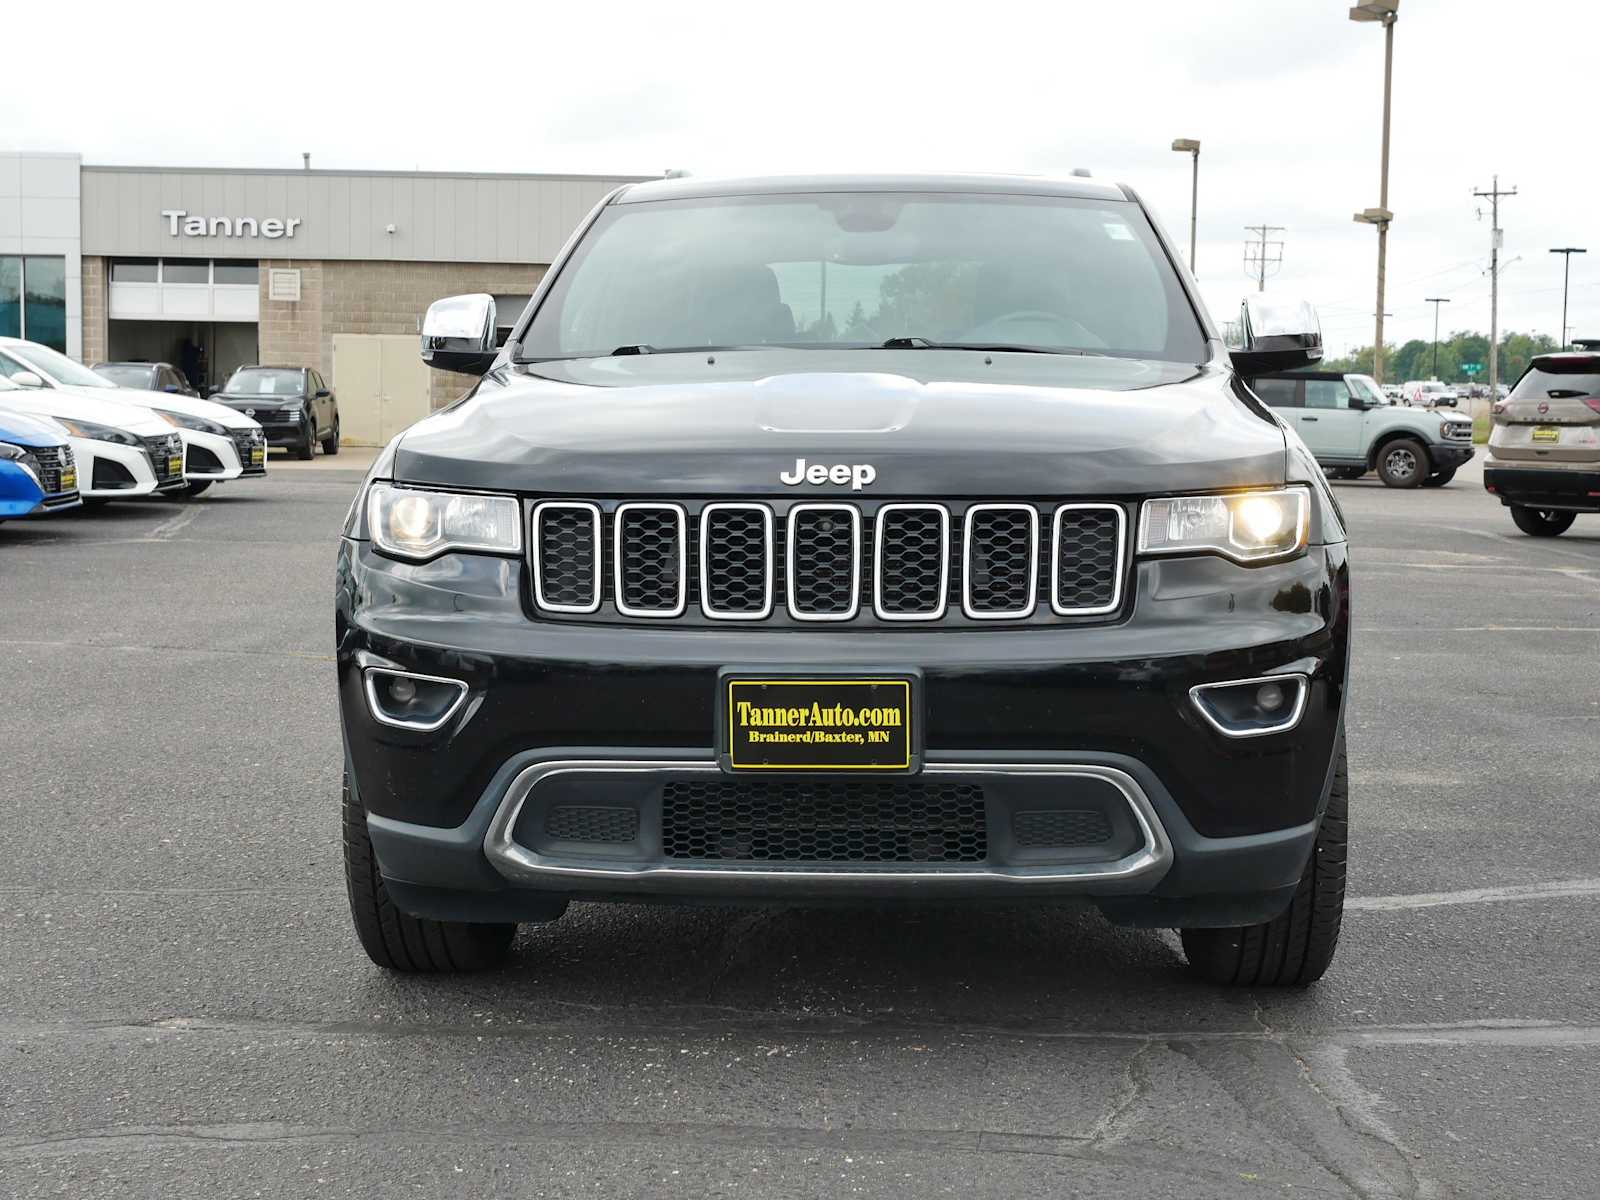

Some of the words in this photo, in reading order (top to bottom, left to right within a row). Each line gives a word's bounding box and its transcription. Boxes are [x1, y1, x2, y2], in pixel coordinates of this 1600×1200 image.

[161, 209, 302, 239] Tanner
[780, 458, 877, 491] Jeep
[737, 701, 902, 727] TannerAuto.com
[748, 730, 865, 745] Brainerd/Baxter,
[867, 730, 891, 743] MN
